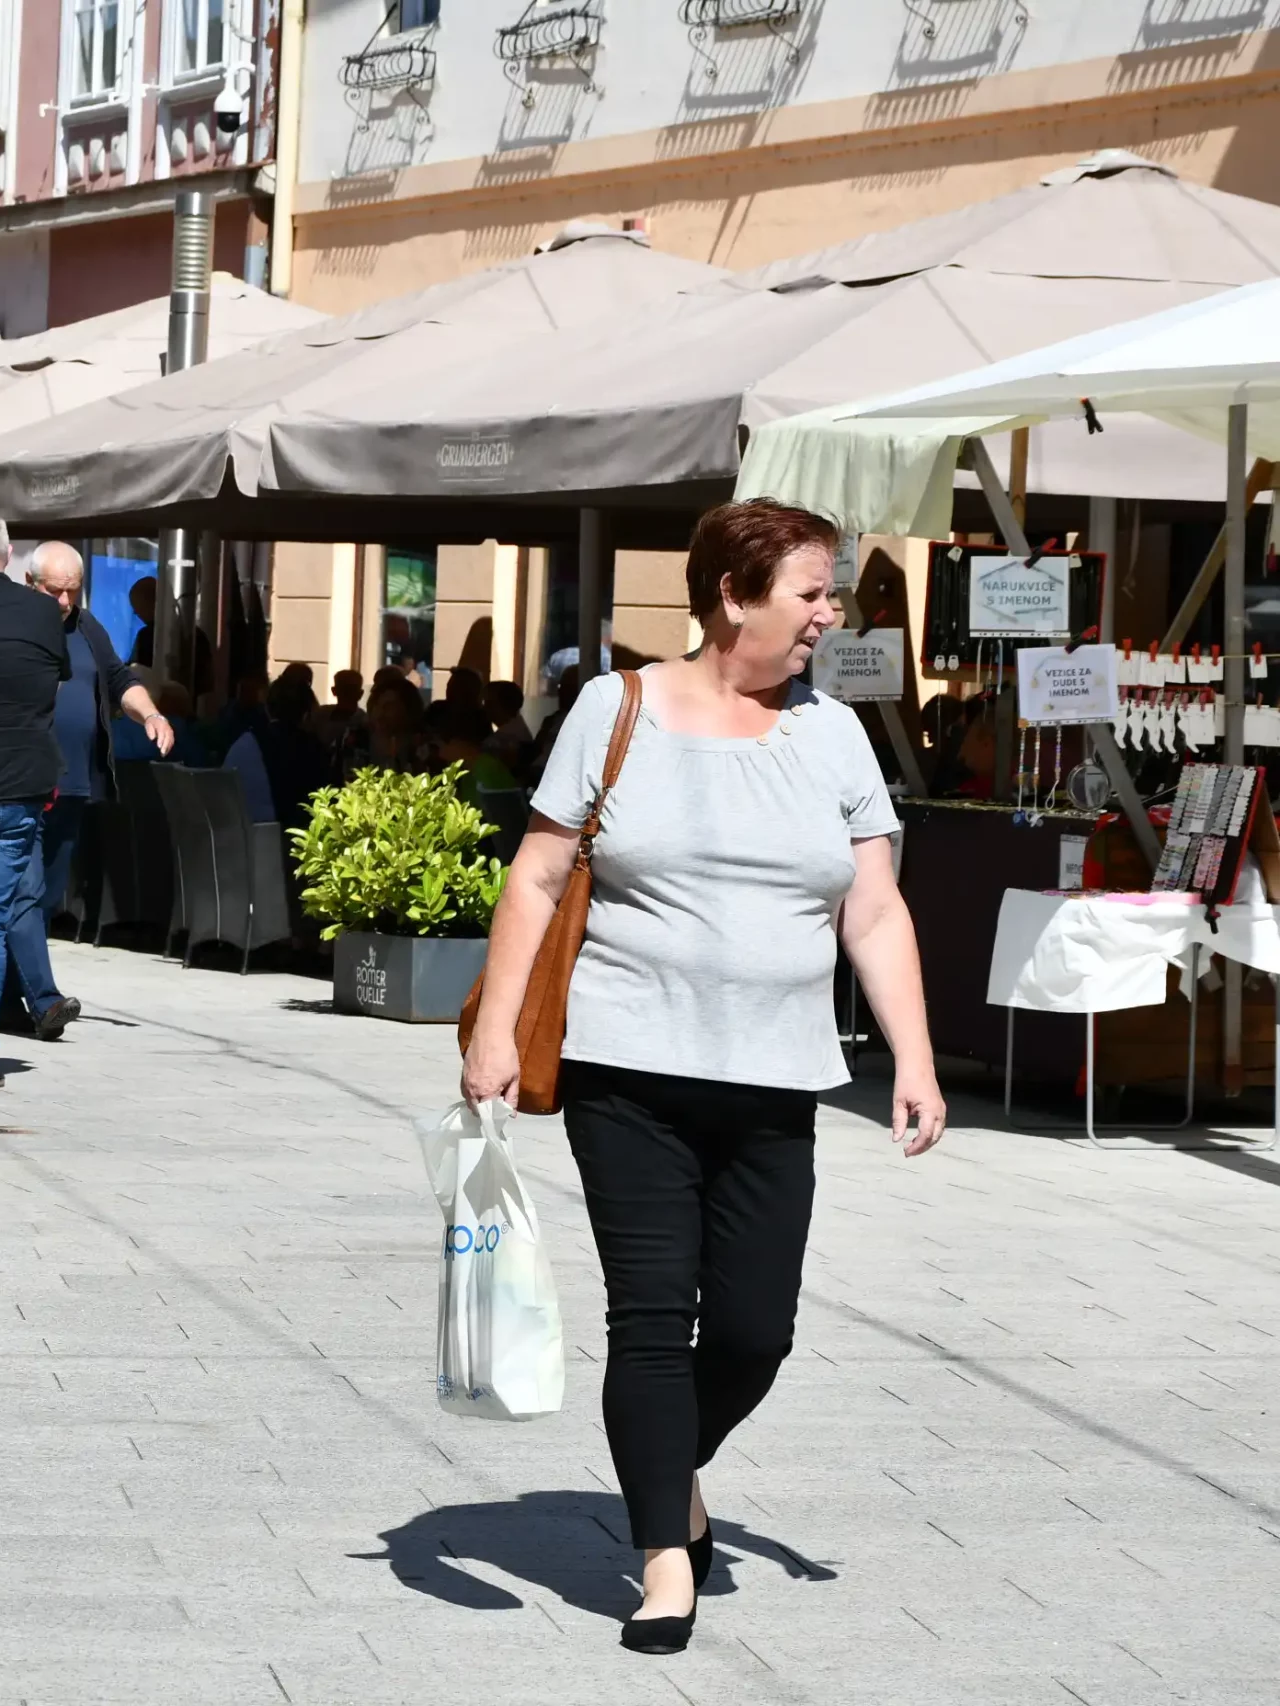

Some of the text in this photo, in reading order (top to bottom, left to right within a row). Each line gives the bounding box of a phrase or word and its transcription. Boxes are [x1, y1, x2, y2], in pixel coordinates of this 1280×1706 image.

[441, 441, 509, 467] GRIMBERGEN
[982, 581, 1057, 592] NARUKVICE
[987, 595, 1051, 605] S IMENOM
[834, 647, 884, 656] VEZICE ZA
[841, 658, 877, 666] DUDE S
[837, 668, 881, 677] IMENOM
[1045, 668, 1092, 677] VEZICE ZA
[1053, 678, 1085, 687] DUDE S
[1049, 688, 1090, 697] IMENOM
[356, 985, 387, 1006] QUELLE
